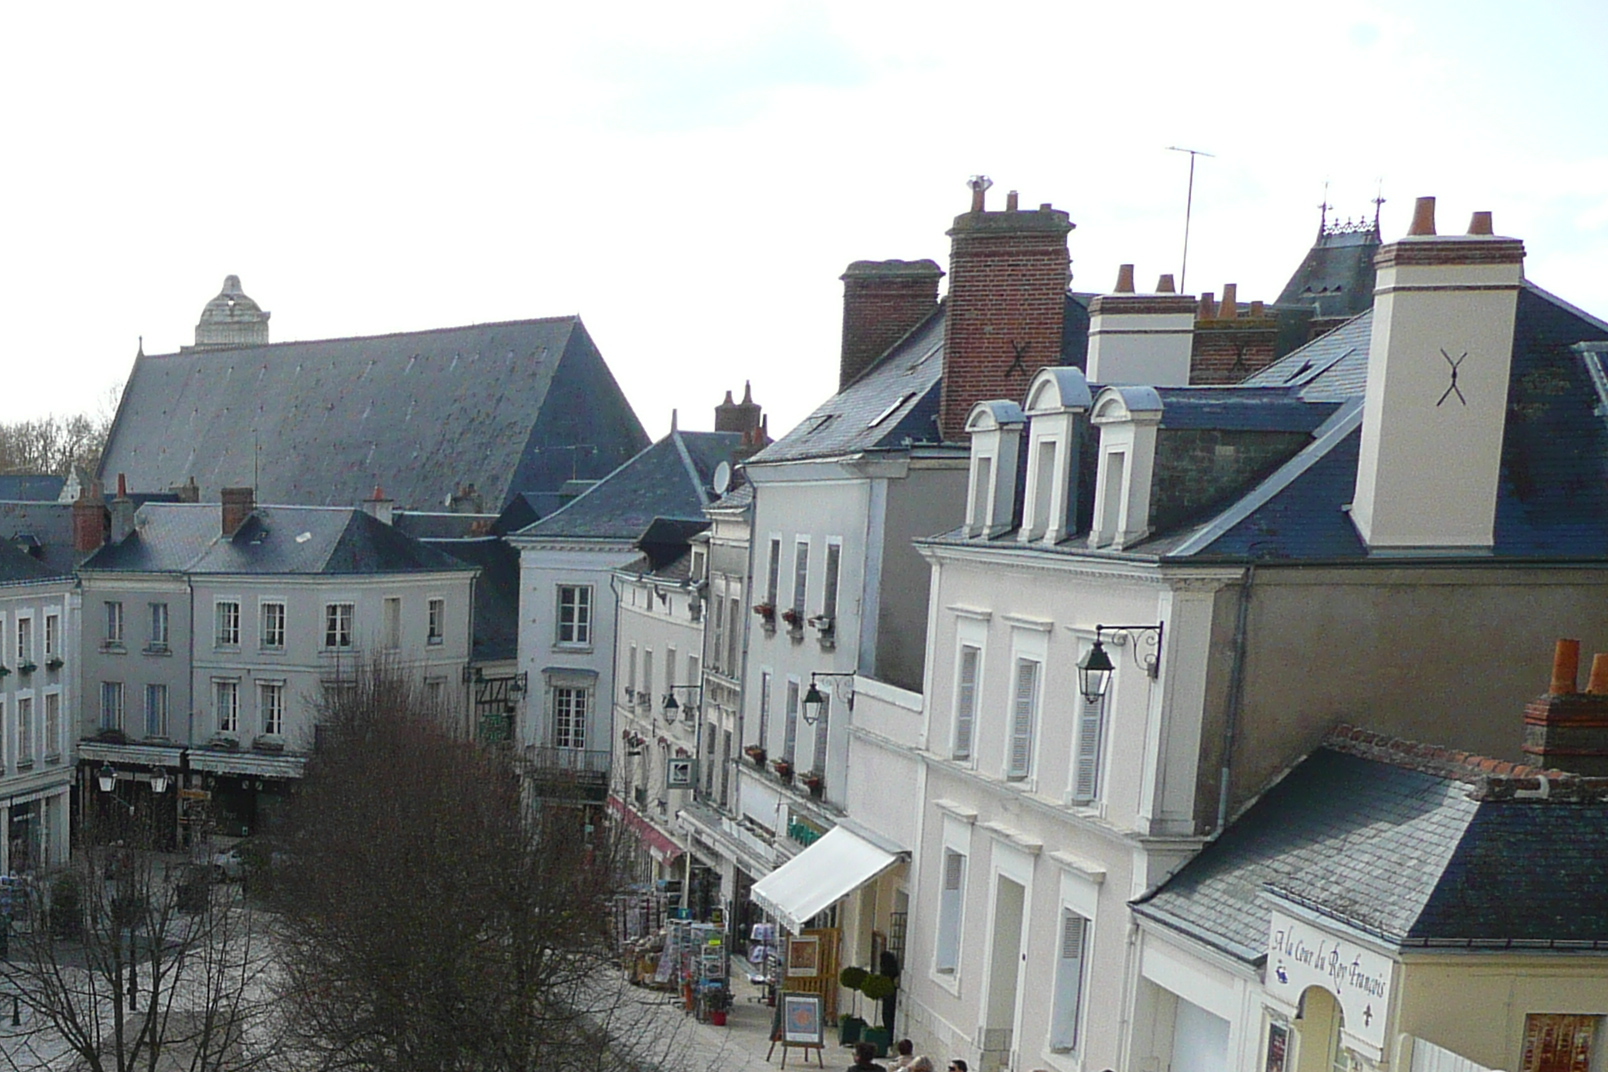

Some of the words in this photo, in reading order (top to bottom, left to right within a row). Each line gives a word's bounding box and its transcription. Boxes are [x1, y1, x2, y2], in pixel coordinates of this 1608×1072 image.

[1271, 930, 1285, 952] A
[1285, 925, 1294, 957] la
[1314, 939, 1326, 971] du
